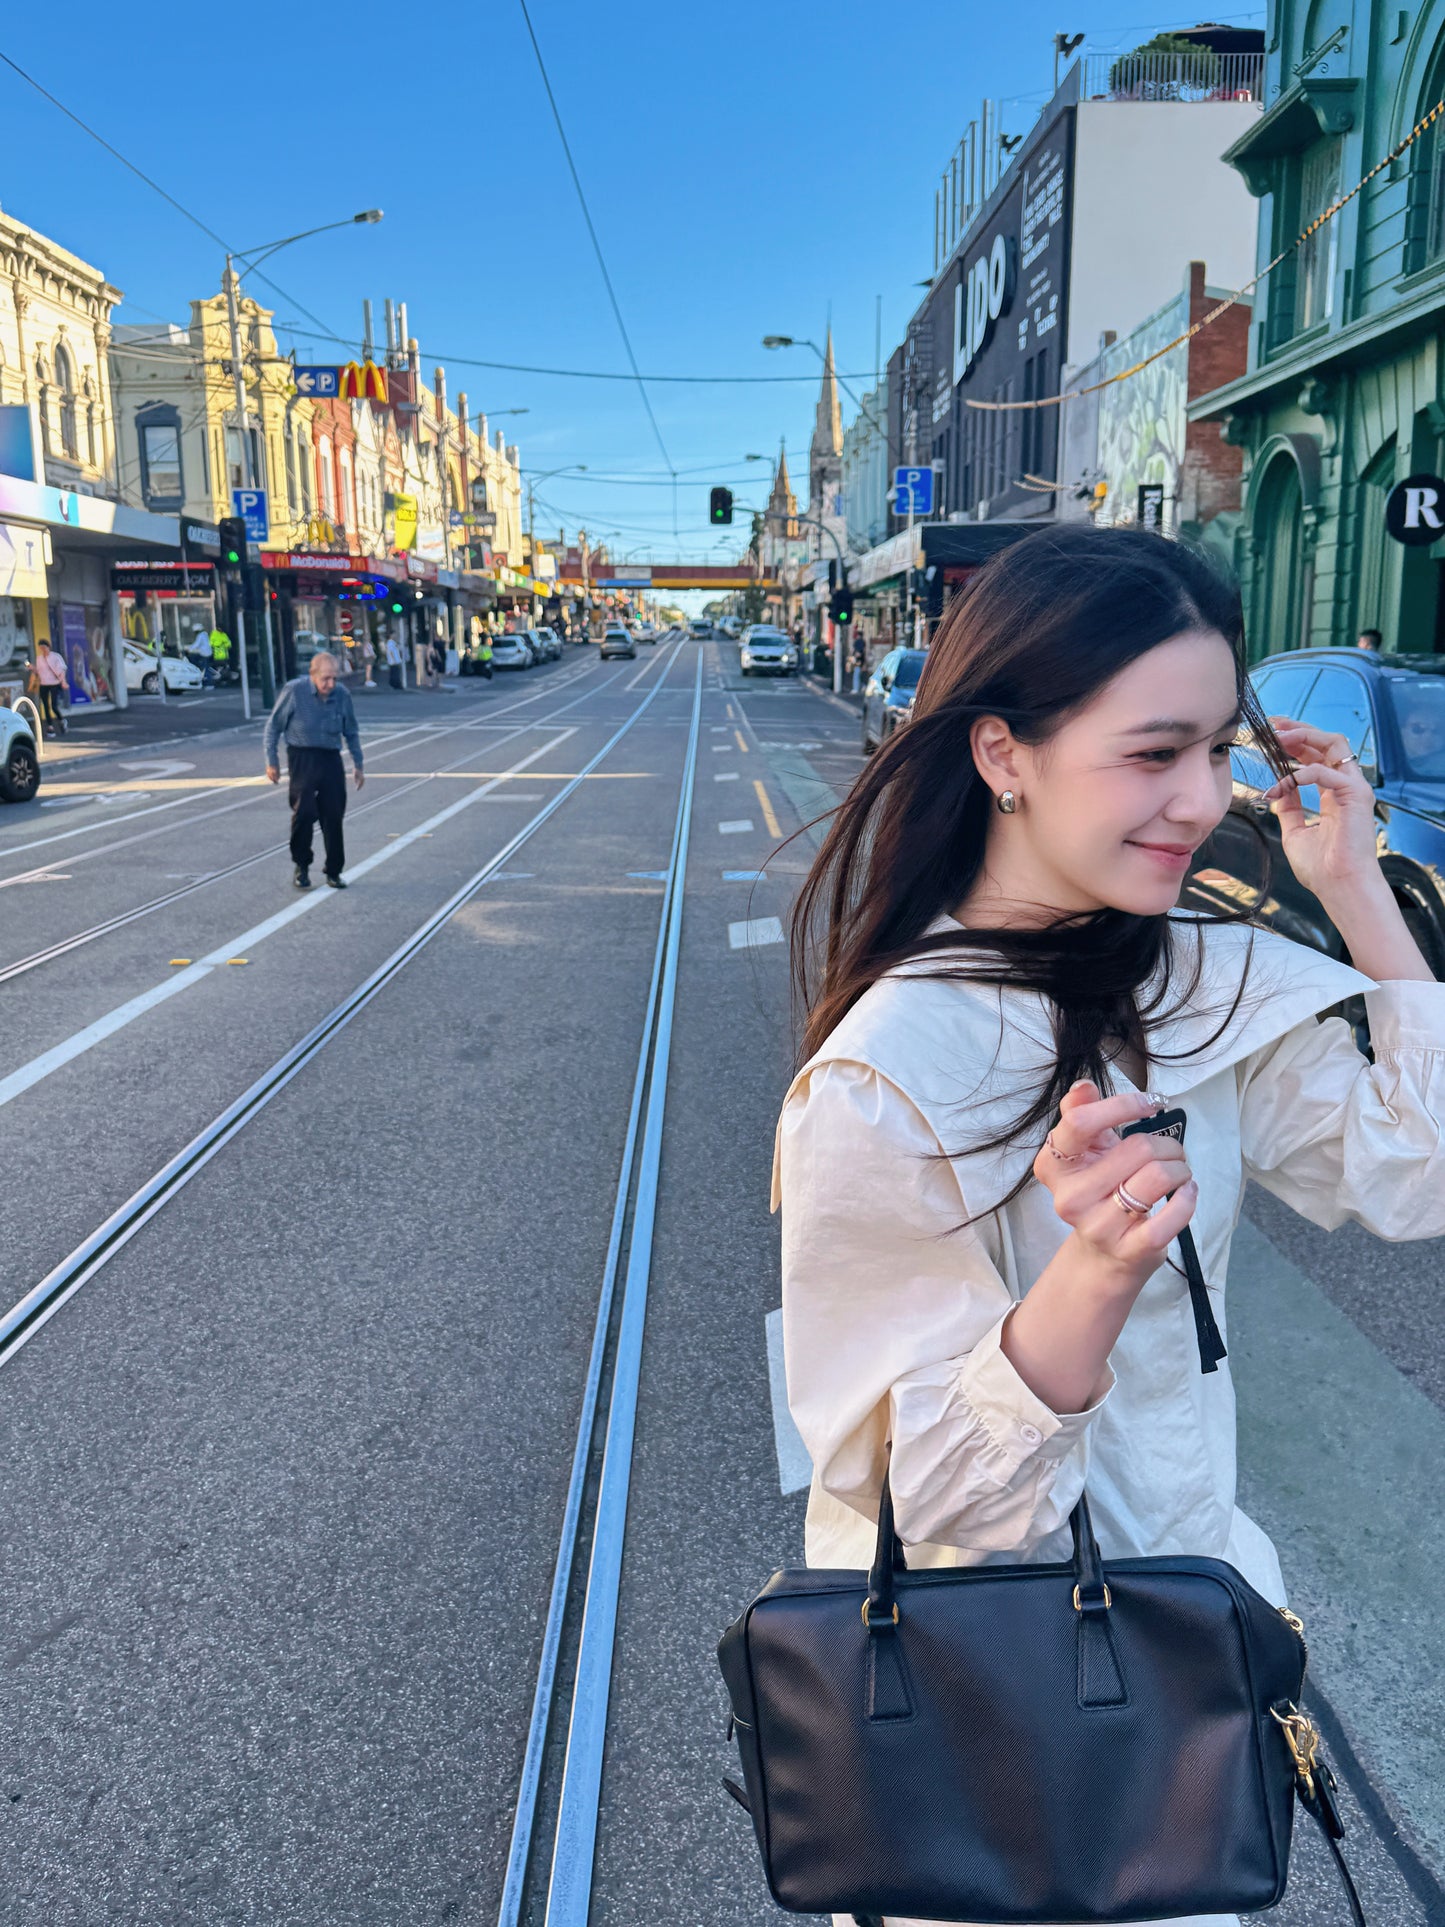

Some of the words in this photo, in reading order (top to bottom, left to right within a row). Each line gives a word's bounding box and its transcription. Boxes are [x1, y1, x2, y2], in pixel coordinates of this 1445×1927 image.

[953, 234, 1006, 387] LIDO
[320, 374, 333, 391] P
[908, 471, 921, 489] P
[241, 493, 258, 514] P
[1403, 488, 1444, 529] R
[290, 555, 351, 569] McDonald's
[1156, 1126, 1180, 1137] RADA
